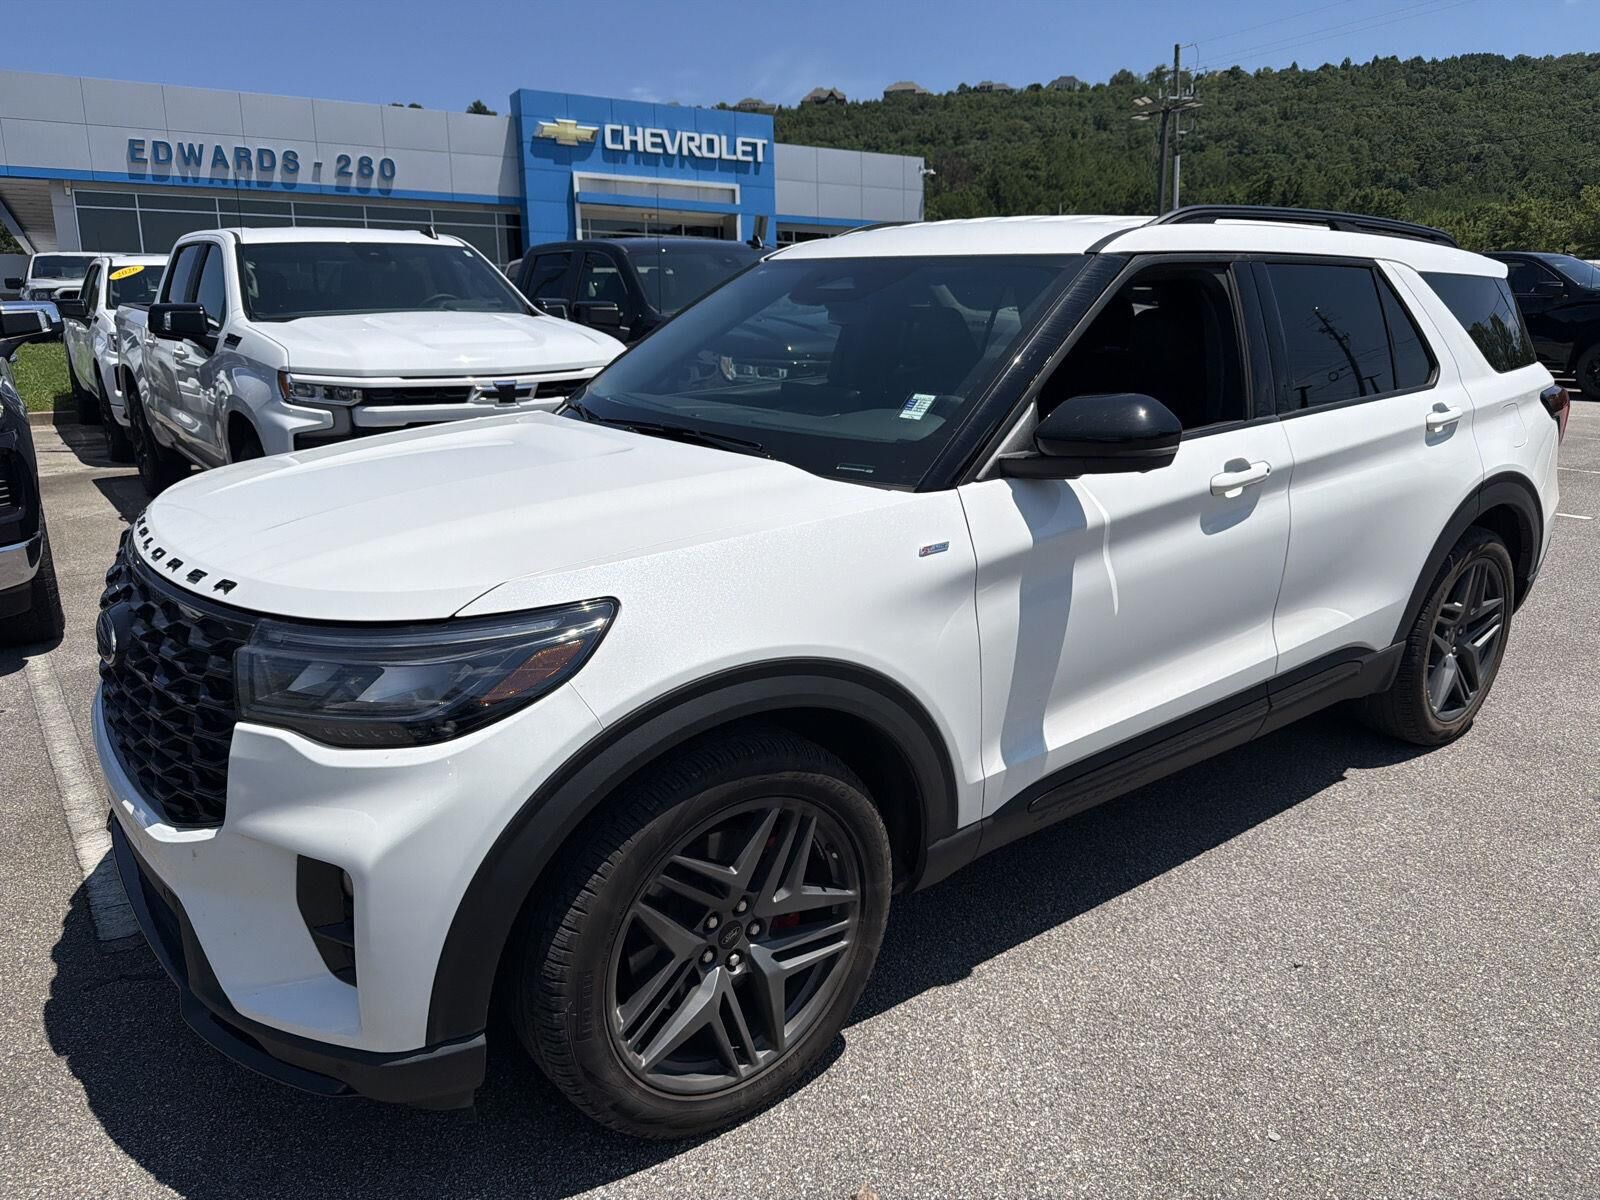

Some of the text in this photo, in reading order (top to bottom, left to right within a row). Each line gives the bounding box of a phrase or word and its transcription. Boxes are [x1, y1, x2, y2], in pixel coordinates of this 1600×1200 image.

[127, 138, 300, 174] EDWARDS
[335, 154, 396, 179] 280
[604, 123, 768, 163] CHEVROLET
